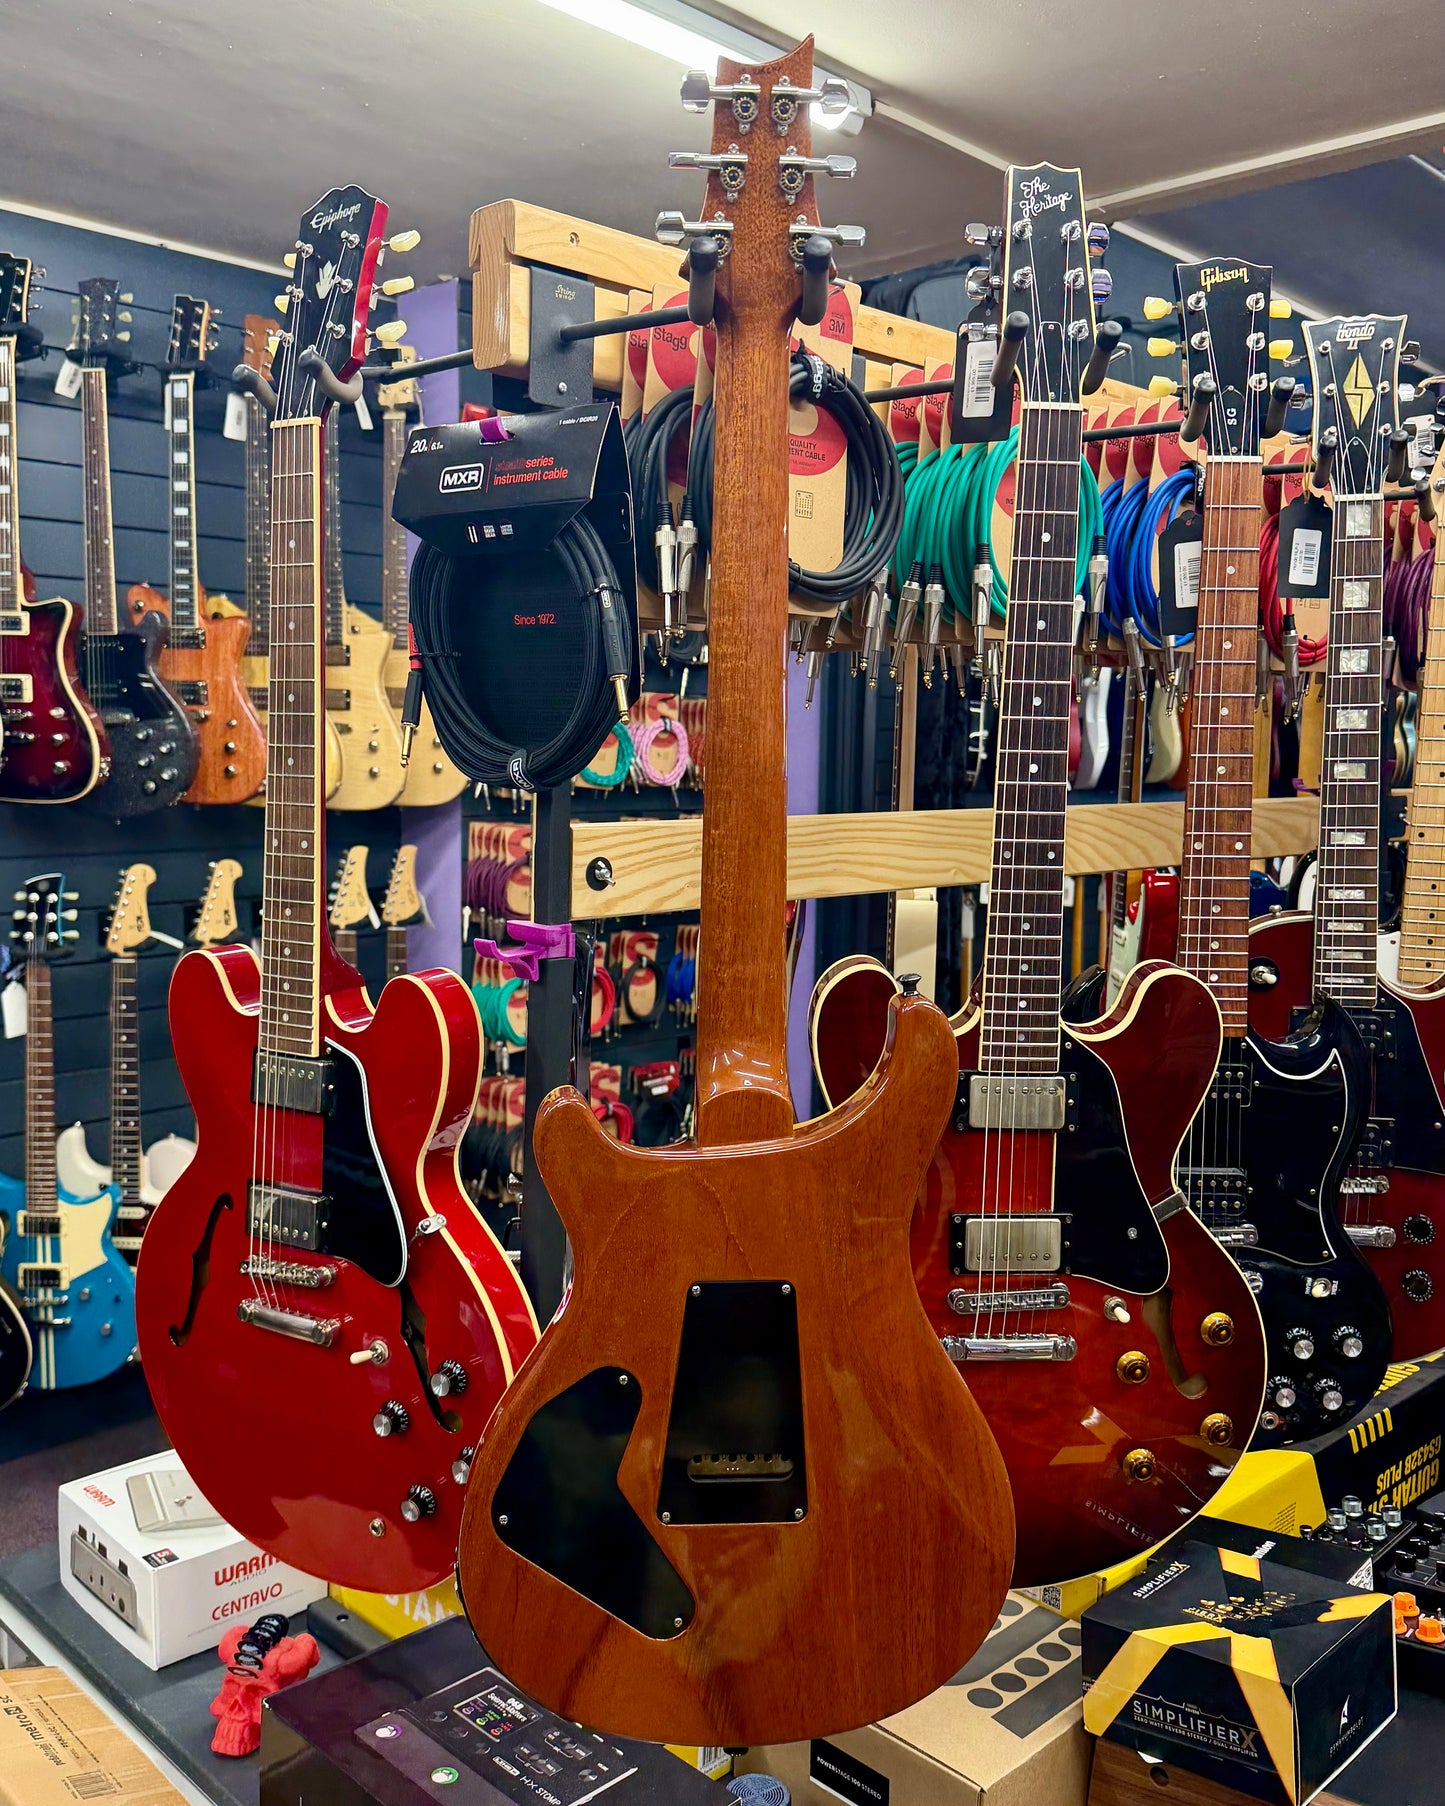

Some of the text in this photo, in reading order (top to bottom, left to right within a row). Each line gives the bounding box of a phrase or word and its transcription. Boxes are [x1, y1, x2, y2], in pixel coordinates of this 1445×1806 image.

[1020, 176, 1050, 198] The
[1019, 192, 1073, 218] Heritage
[309, 203, 361, 234] Epiphone
[1200, 266, 1249, 292] Gibson
[829, 319, 845, 335] 3M
[629, 334, 648, 349] Sta
[653, 327, 688, 351] Stagg
[892, 400, 916, 419] Stagg
[1226, 408, 1237, 425] SG
[790, 439, 817, 450] QUALITY
[525, 455, 554, 469] series
[805, 451, 826, 461] CABLE
[443, 470, 480, 487] MXR
[493, 466, 569, 486] instrument cable
[514, 614, 536, 625] Since
[1376, 1460, 1402, 1495] PLUS
[230, 1570, 267, 1587] AUDIO
[212, 1583, 283, 1620] CENTAVO
[1133, 1715, 1148, 1724] ZERO
[1149, 1720, 1164, 1729] WATT
[1165, 1724, 1186, 1736] REVERB
[1187, 1730, 1208, 1743] STEREO
[1213, 1738, 1228, 1749] DUAL
[1229, 1743, 1259, 1759] AMPLIFIER
[816, 1756, 882, 1800] POWERSTAGE 100 STEREO
[520, 1776, 562, 1806] HX STOMP
